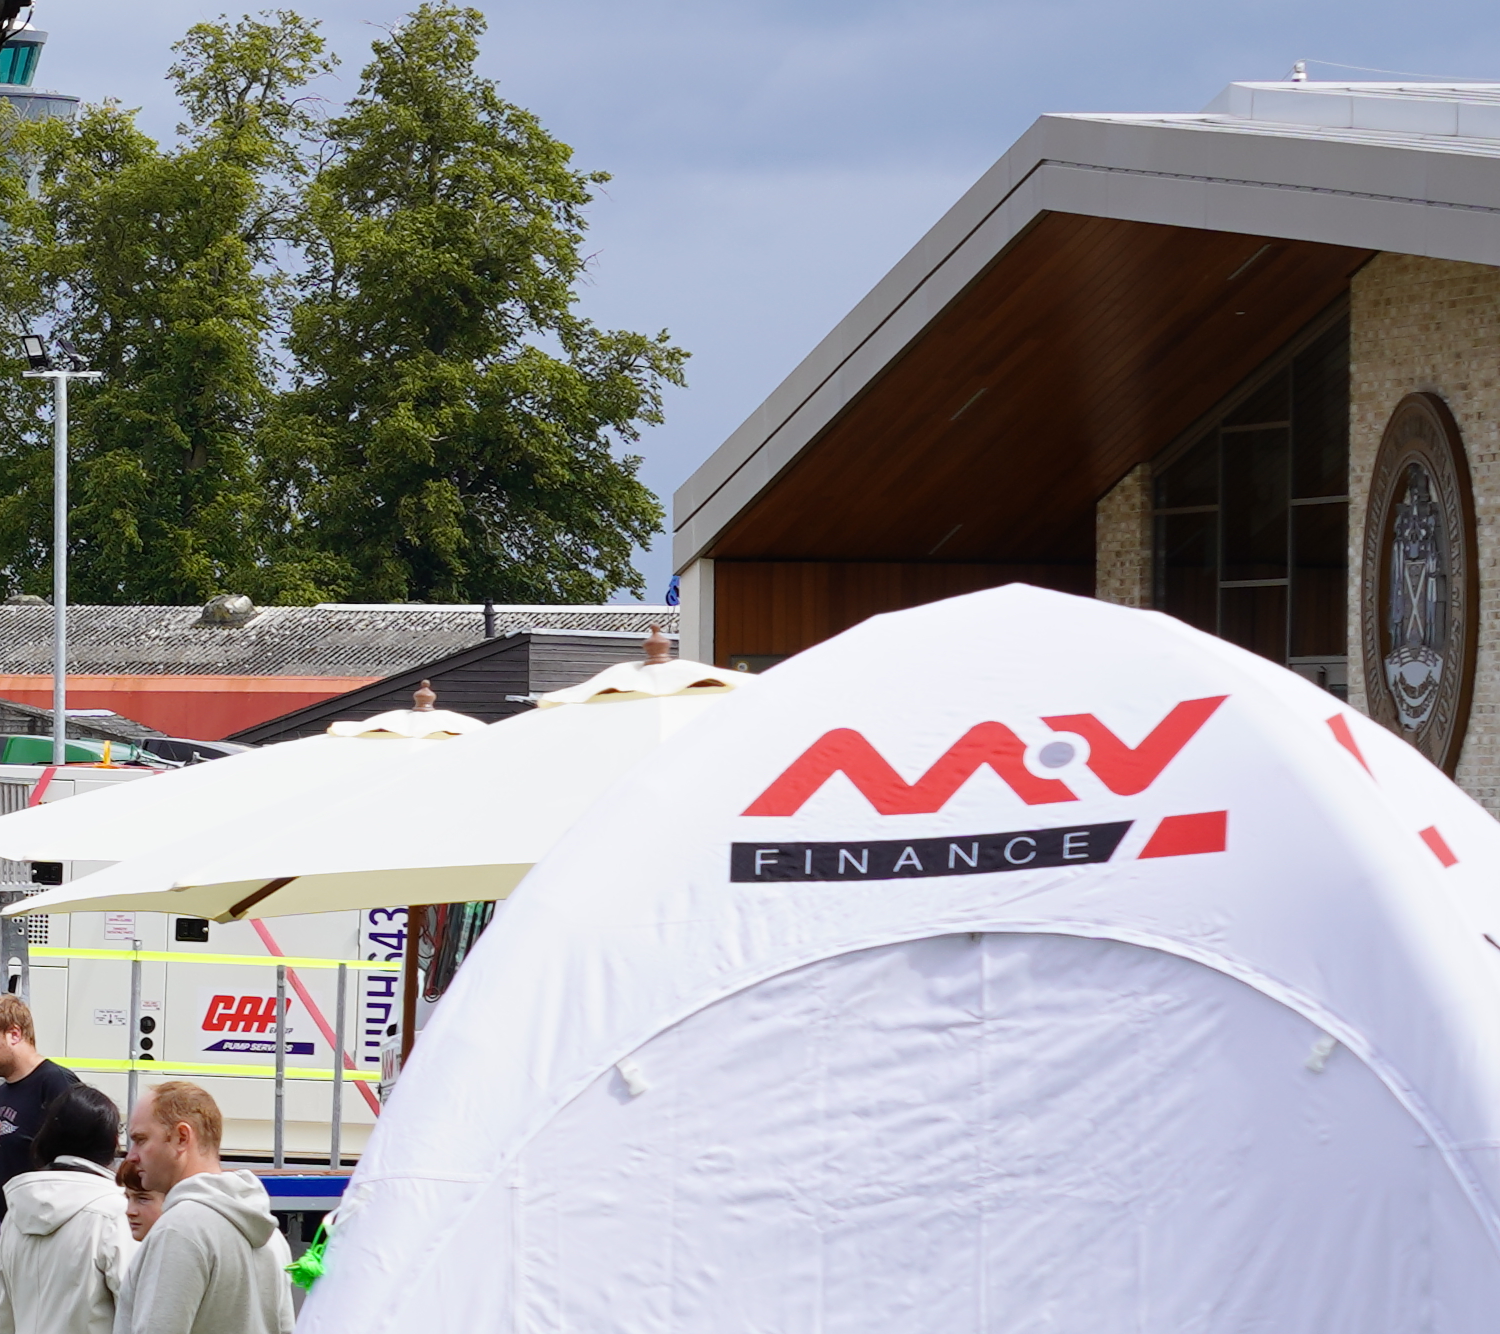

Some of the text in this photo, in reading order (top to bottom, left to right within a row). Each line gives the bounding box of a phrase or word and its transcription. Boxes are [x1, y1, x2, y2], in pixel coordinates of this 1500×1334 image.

[755, 830, 1091, 876] FINANCE
[202, 995, 293, 1033] GAP
[222, 1041, 251, 1051] PUMP
